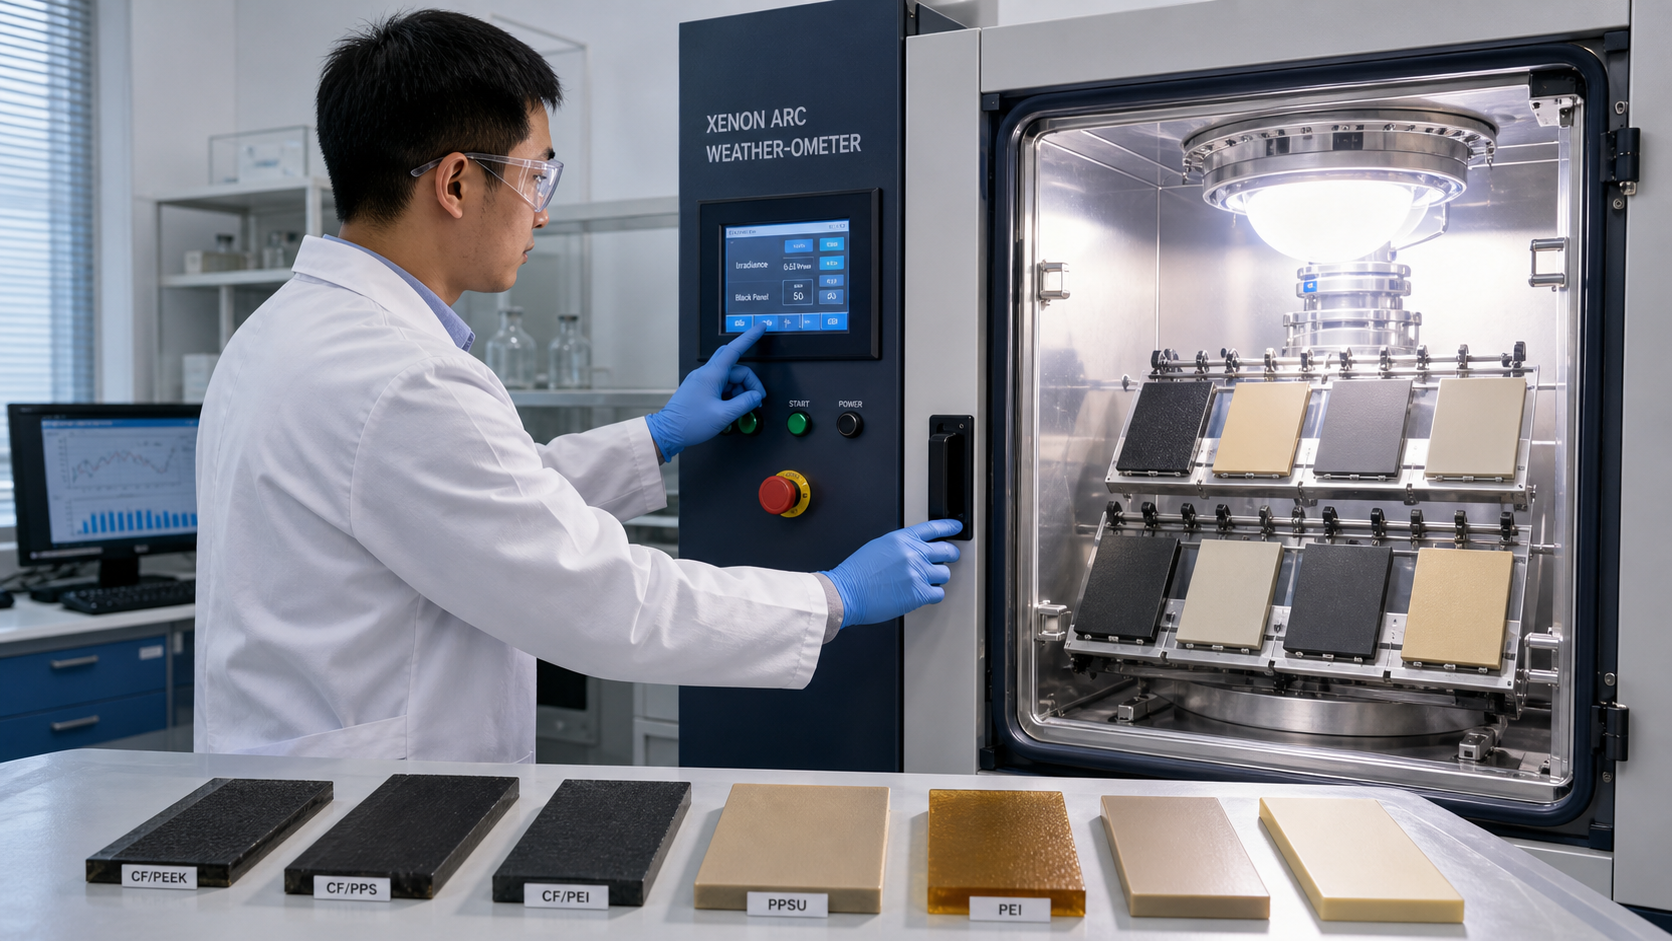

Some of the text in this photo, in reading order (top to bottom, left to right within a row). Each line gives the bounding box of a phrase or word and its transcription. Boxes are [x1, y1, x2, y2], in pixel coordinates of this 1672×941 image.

[706, 106, 807, 133] XENON ARC
[706, 133, 862, 163] WEATHER-OMETER
[735, 293, 752, 302] Black
[788, 400, 810, 408] START
[838, 400, 863, 409] POWER
[131, 870, 188, 884] CF/PEEK
[326, 881, 378, 896] CF/PPS
[541, 889, 590, 903] CF/PEI
[768, 898, 807, 912] PPSU
[999, 903, 1022, 917] PEI
